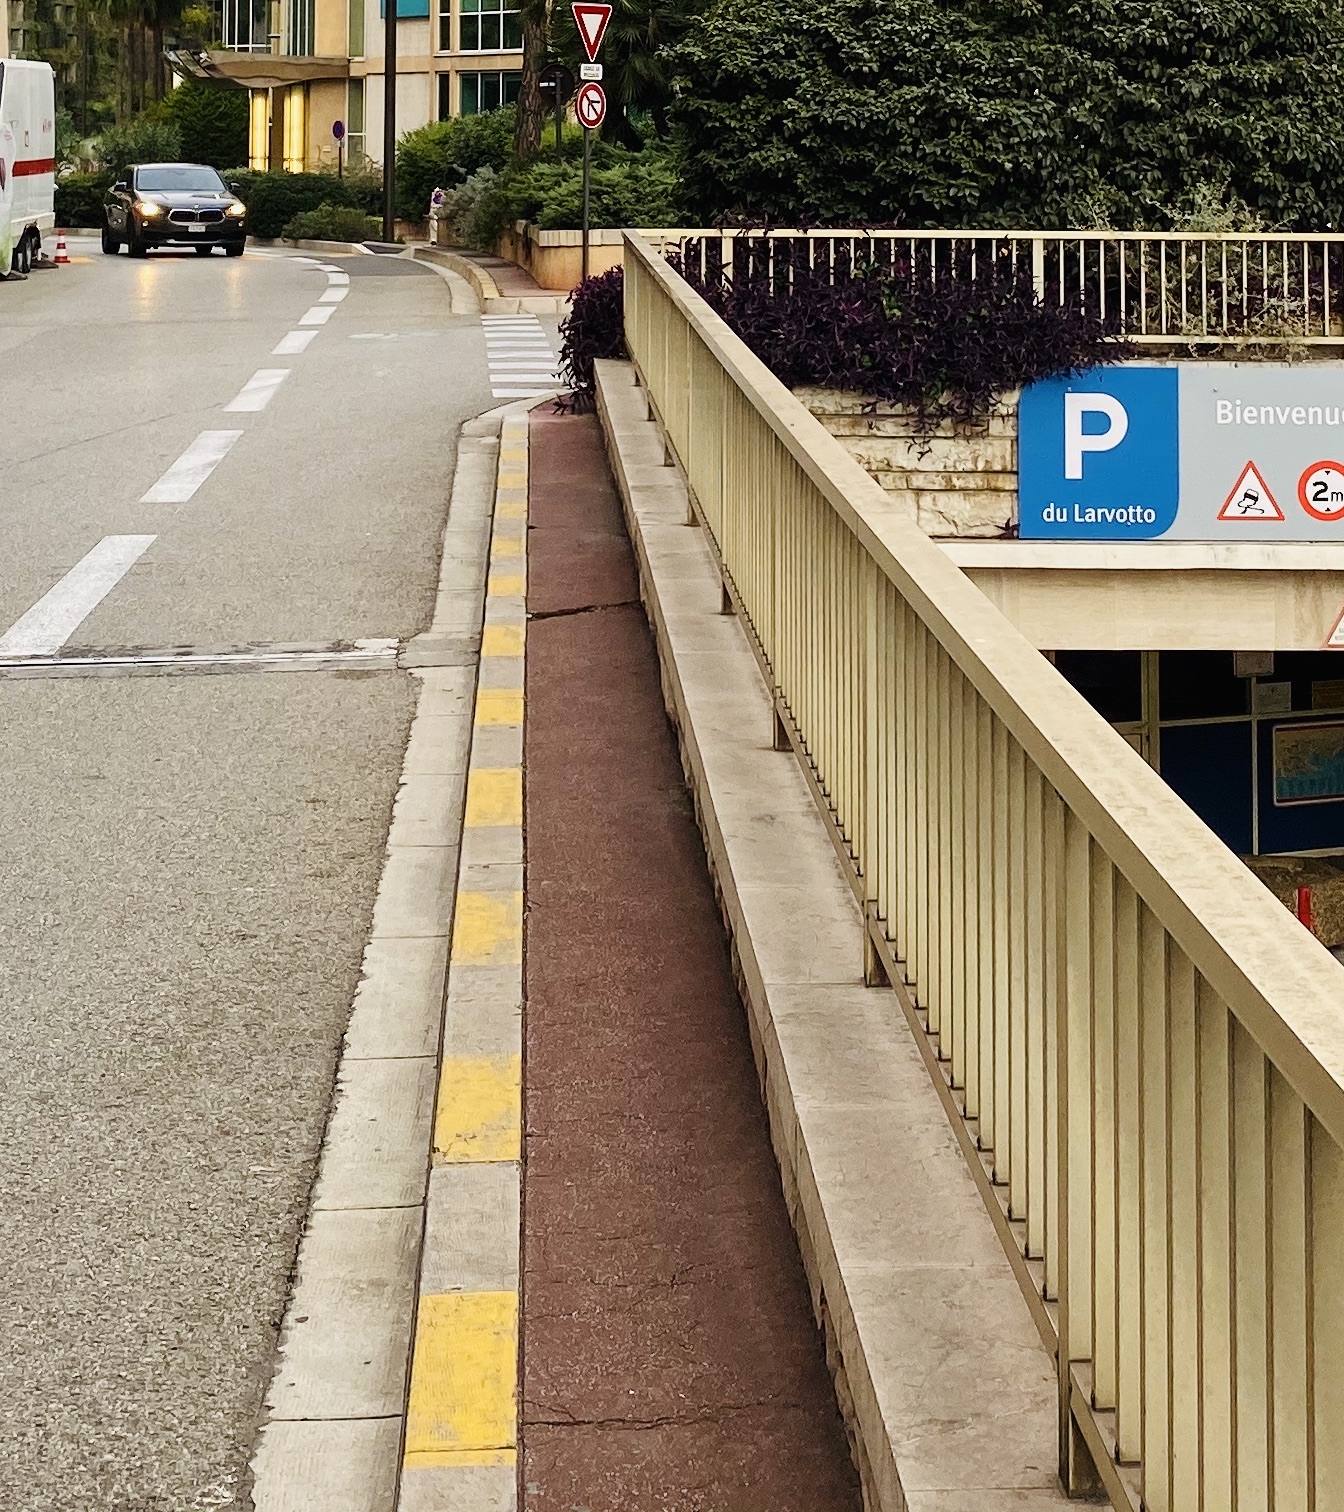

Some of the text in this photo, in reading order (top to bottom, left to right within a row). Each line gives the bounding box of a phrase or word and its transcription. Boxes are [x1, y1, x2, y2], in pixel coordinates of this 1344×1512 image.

[1064, 392, 1129, 480] P
[1042, 502, 1157, 524] du Larvotto
